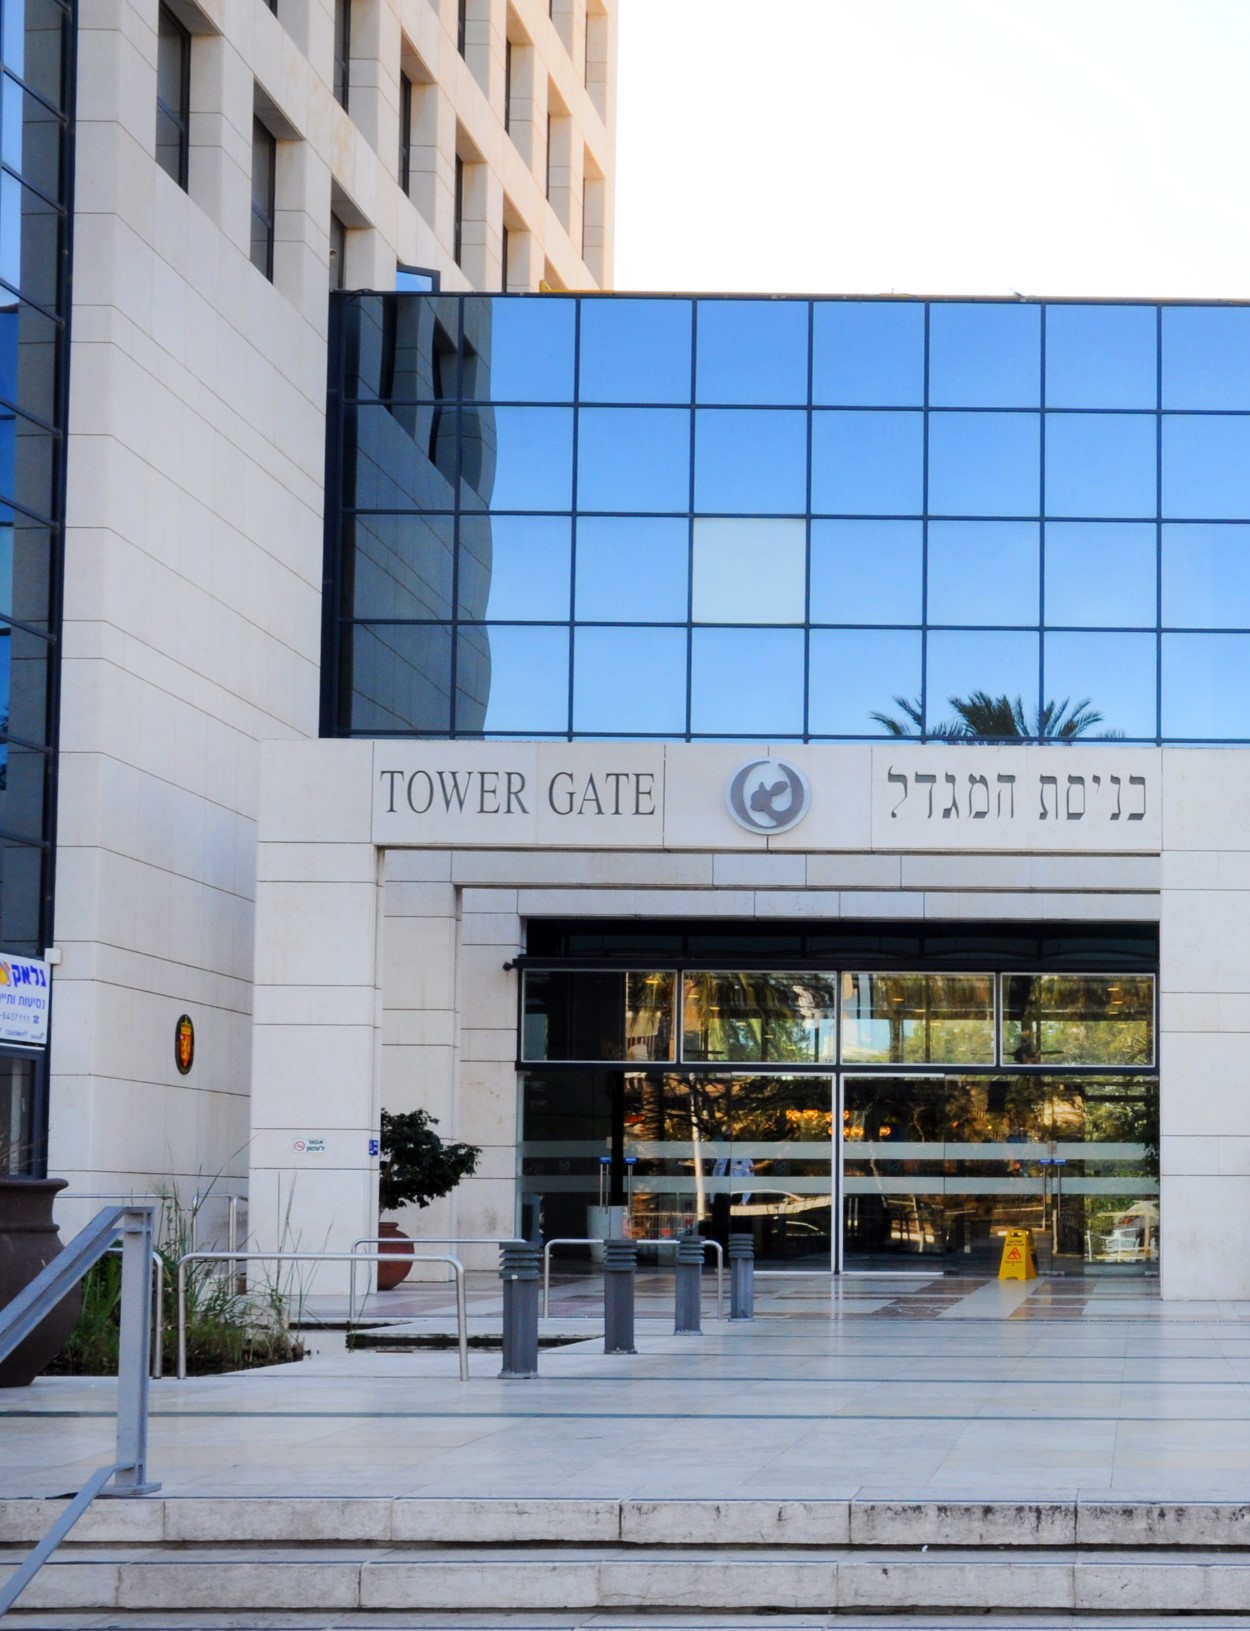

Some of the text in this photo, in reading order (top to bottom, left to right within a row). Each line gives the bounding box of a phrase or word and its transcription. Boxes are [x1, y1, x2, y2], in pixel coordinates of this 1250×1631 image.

[380, 769, 657, 816] TOWER GATE
[887, 766, 1147, 822] כניסת המגדל
[11, 964, 47, 988] גלאק
[0, 993, 46, 1010] נסיעות ותיי
